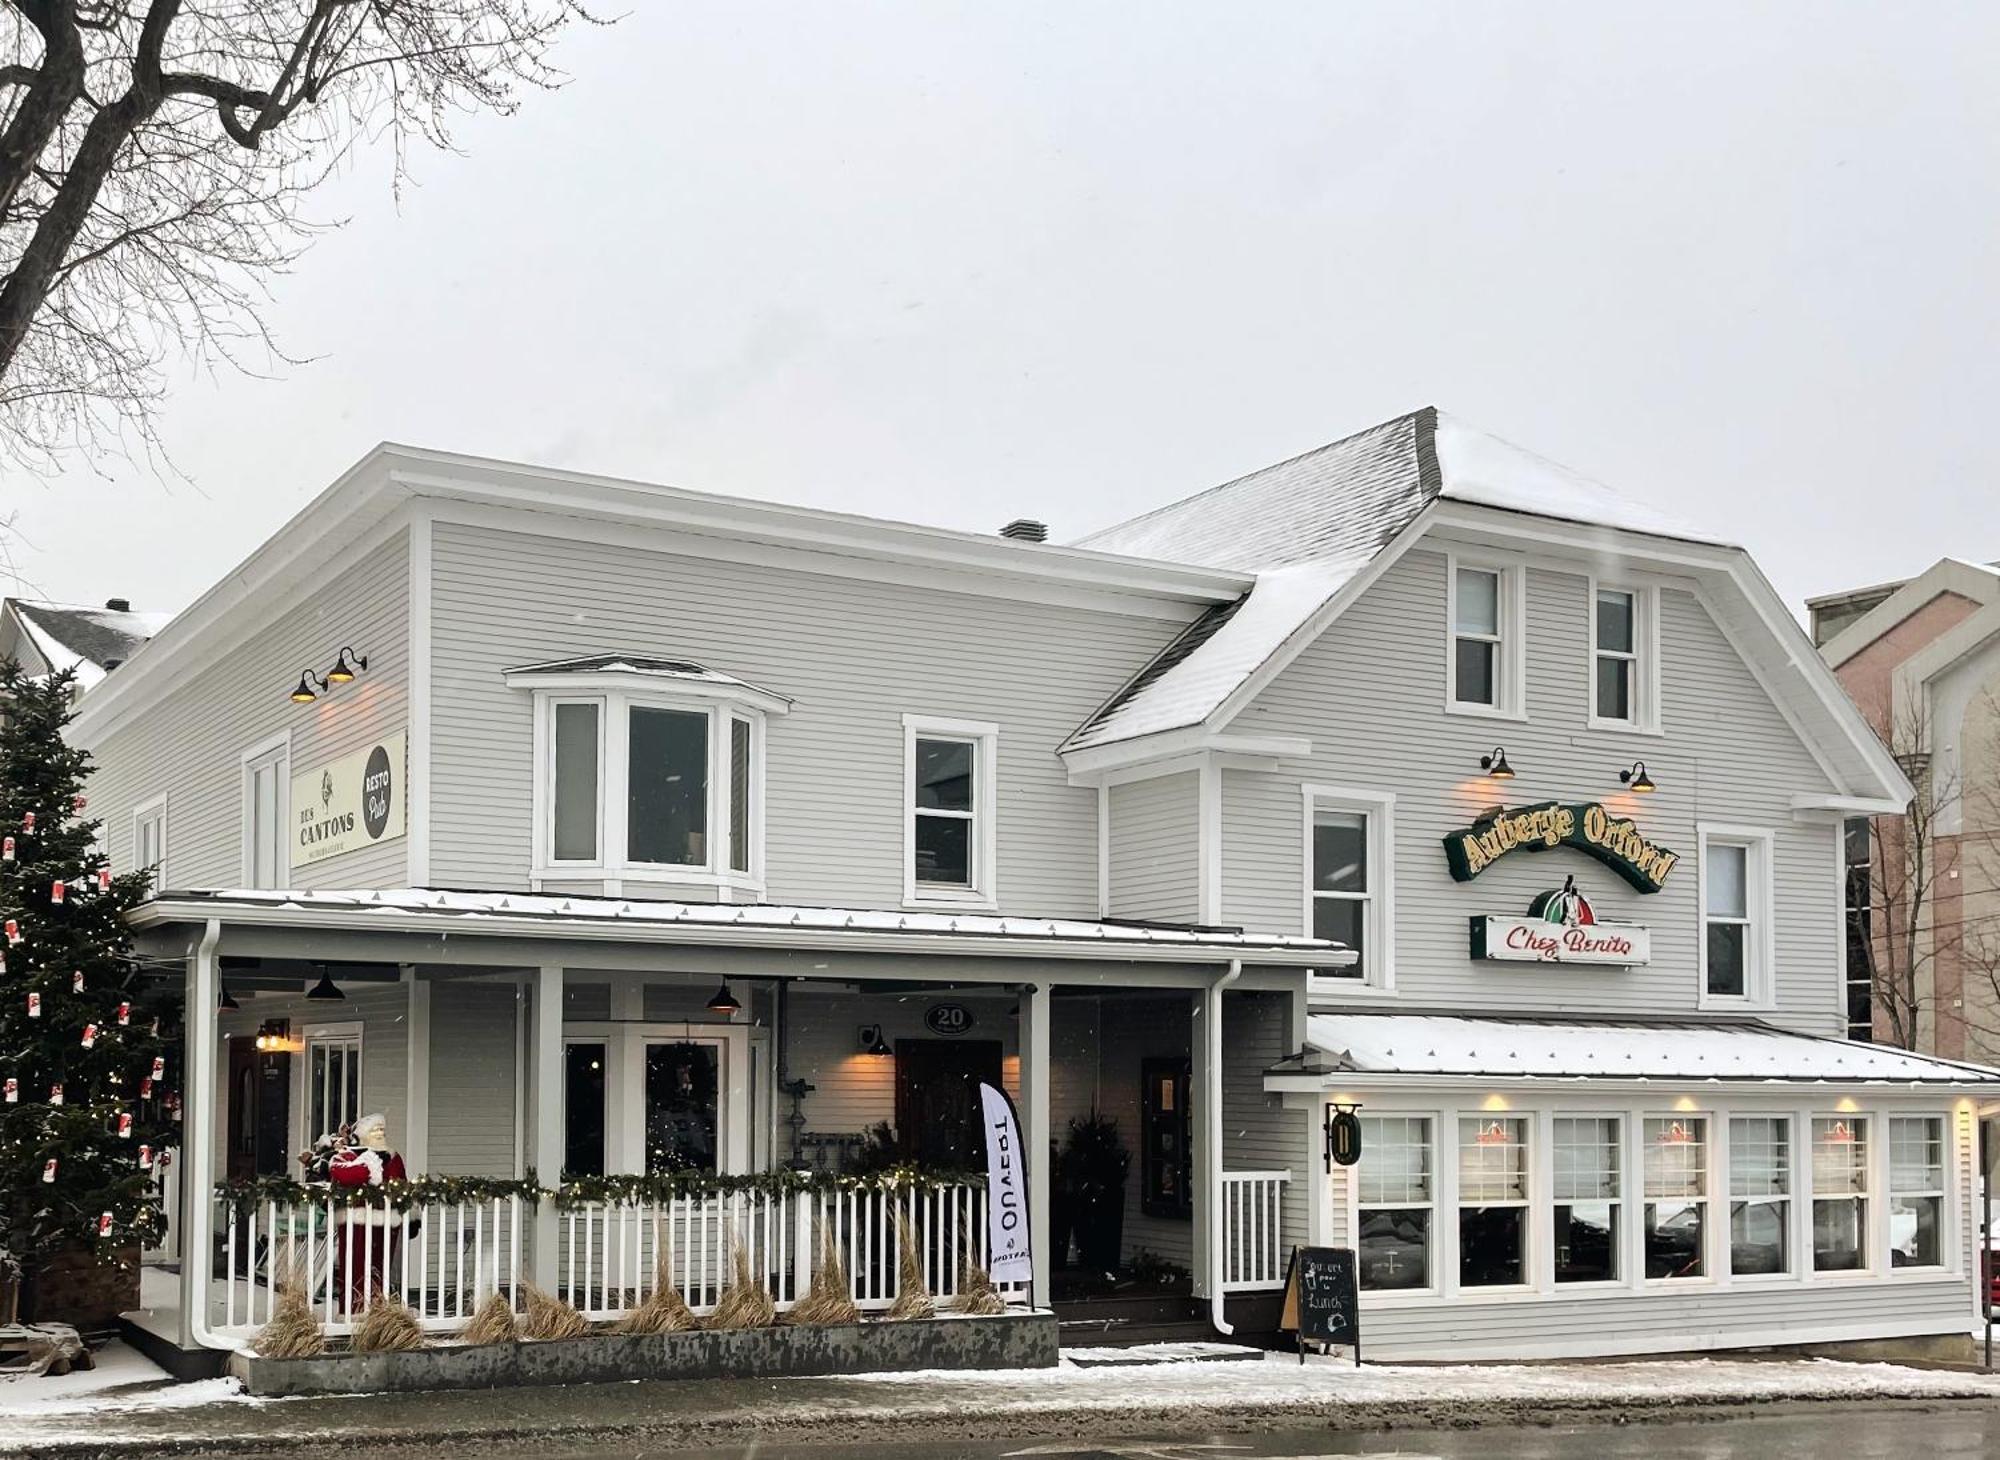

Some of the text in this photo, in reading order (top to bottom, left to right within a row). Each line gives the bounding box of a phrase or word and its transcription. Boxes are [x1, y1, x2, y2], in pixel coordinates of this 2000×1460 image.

[366, 770, 389, 792] RESTO
[369, 790, 386, 822] Pub
[300, 812, 354, 846] CANTONS
[1463, 806, 1680, 886] Auberge Orford
[1506, 926, 1632, 957] Chez Benito
[938, 1008, 964, 1026] 20
[1310, 1262, 1343, 1273] Ouert
[1309, 1293, 1342, 1309] Lunch
